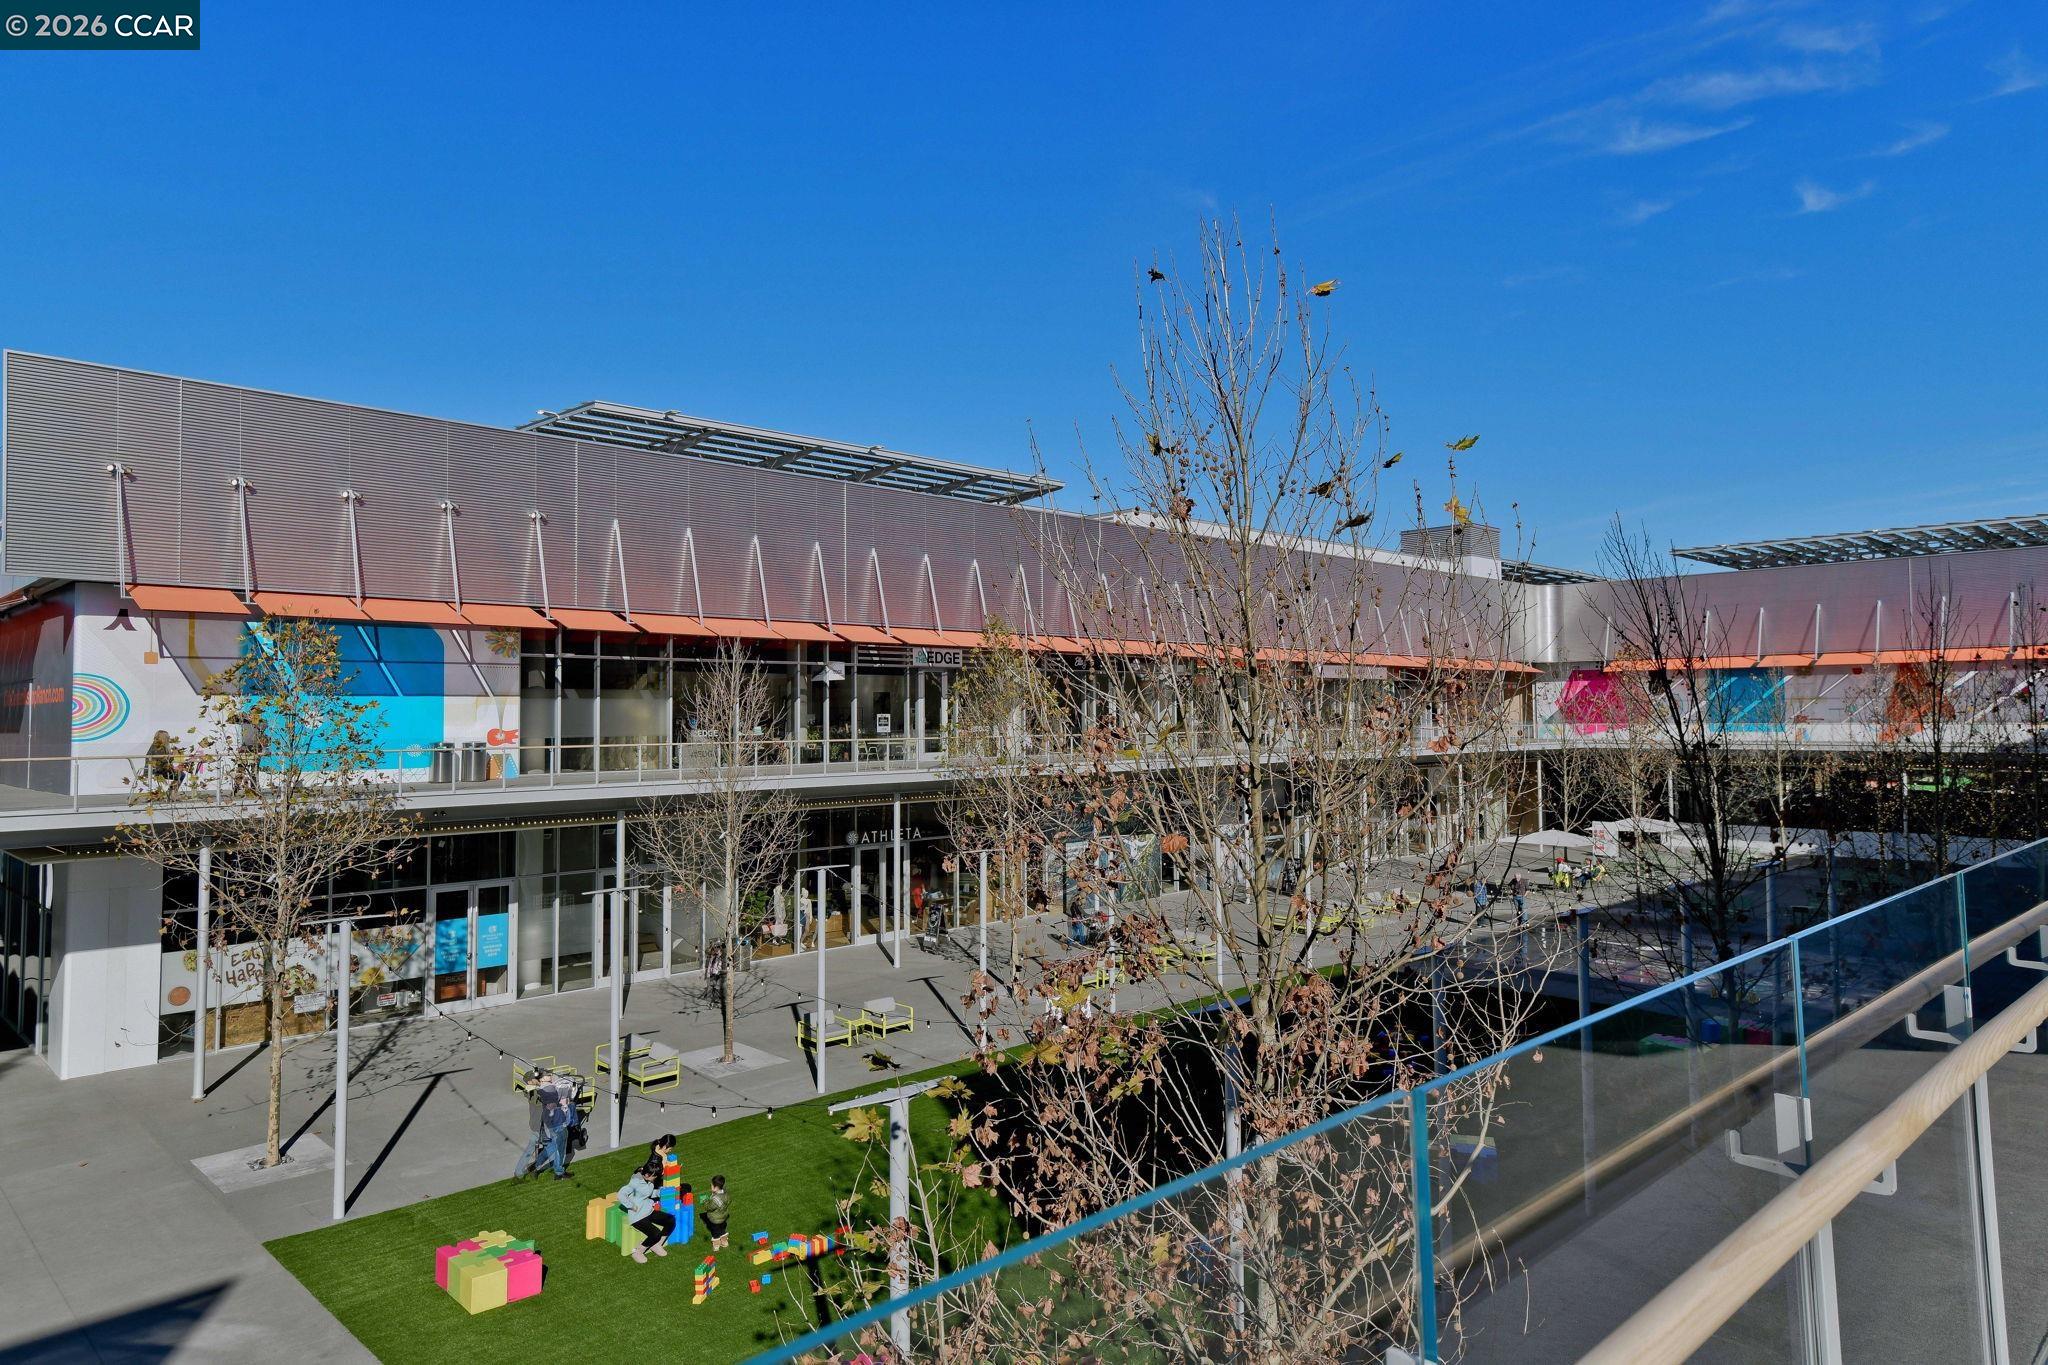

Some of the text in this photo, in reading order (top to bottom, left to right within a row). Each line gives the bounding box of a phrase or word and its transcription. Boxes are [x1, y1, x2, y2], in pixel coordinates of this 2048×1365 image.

[927, 651, 960, 664] EDGE
[861, 827, 922, 844] ATHLETA
[231, 947, 259, 967] Eat
